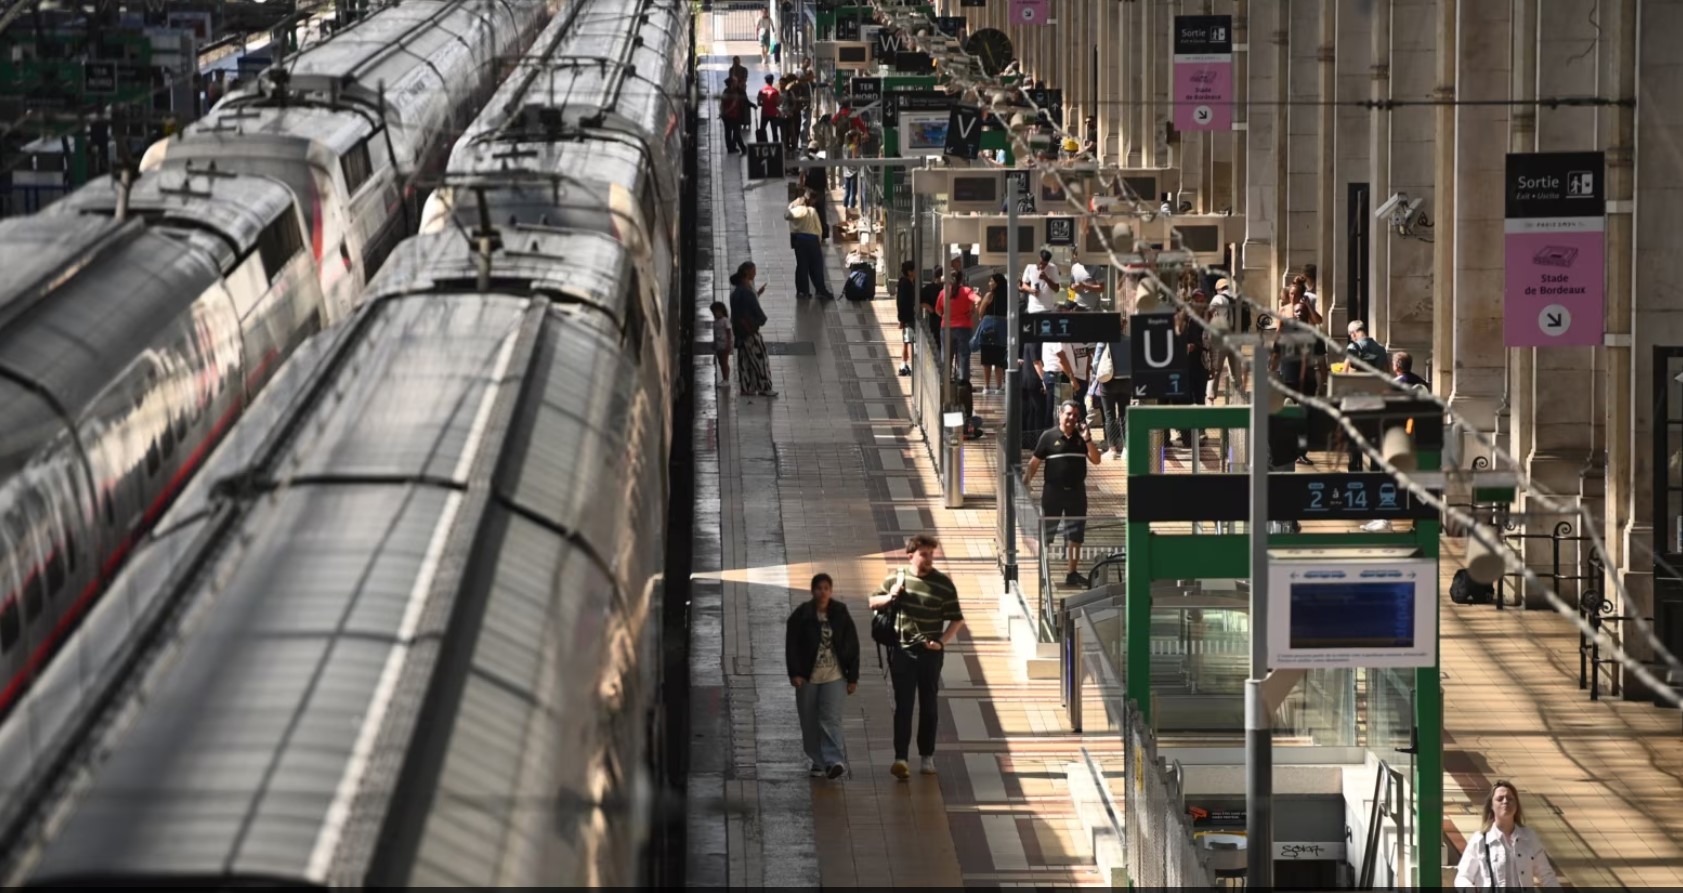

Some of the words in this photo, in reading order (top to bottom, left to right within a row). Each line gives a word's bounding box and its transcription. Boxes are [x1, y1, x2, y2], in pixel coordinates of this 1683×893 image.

[1181, 28, 1207, 38] Sortie
[880, 34, 900, 52] W
[859, 82, 874, 91] TER
[957, 114, 977, 139] V
[755, 146, 776, 157] TGV
[760, 159, 769, 177] 1
[1517, 175, 1560, 189] Sortie
[1541, 273, 1569, 283] Stade
[1524, 286, 1538, 295] de
[1540, 285, 1586, 295] Bordeaux
[1061, 324, 1069, 334] 1
[1143, 329, 1174, 368] U
[1171, 380, 1180, 393] 1
[1310, 490, 1323, 508] 2
[1344, 490, 1368, 508] 14
